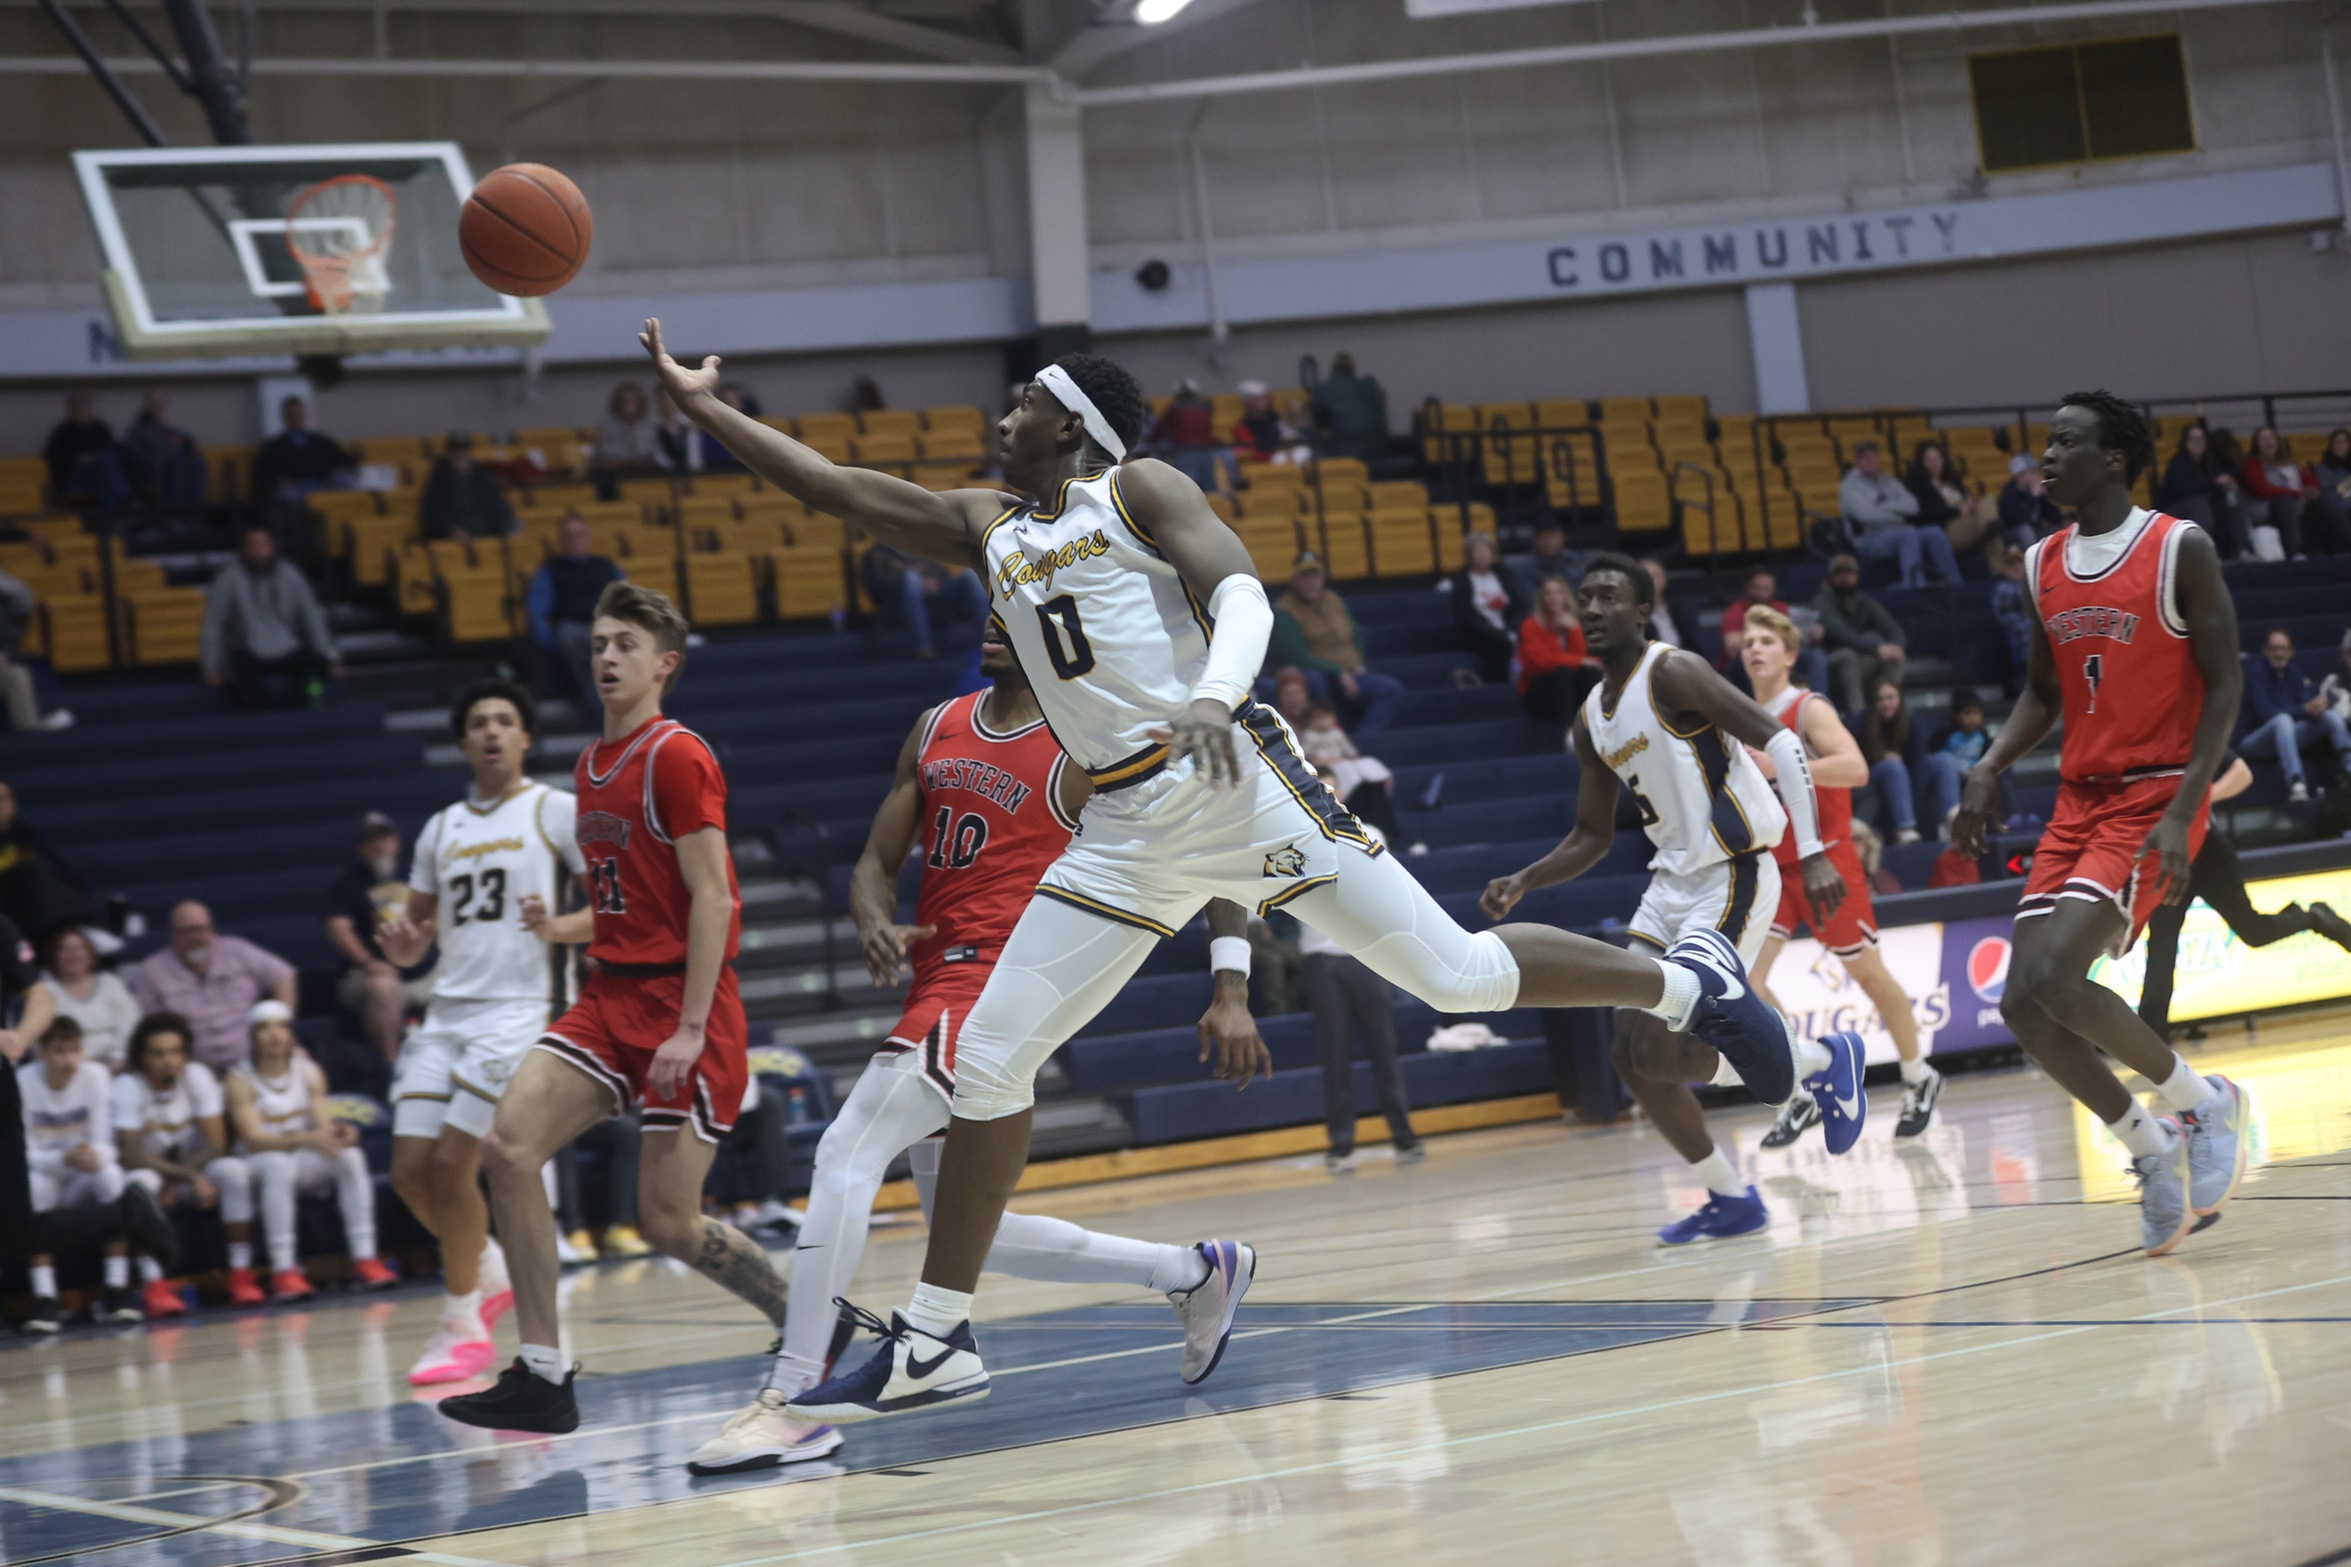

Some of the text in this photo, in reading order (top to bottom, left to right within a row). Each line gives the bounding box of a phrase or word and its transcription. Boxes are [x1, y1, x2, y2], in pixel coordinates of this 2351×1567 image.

[1547, 213, 1959, 288] COMMUNITY
[998, 529, 1110, 600] Cougars
[1035, 594, 1096, 681] 0
[2083, 654, 2103, 714] 1
[924, 757, 1032, 815] WESTERN
[929, 805, 989, 870] 10
[450, 867, 506, 927] 23
